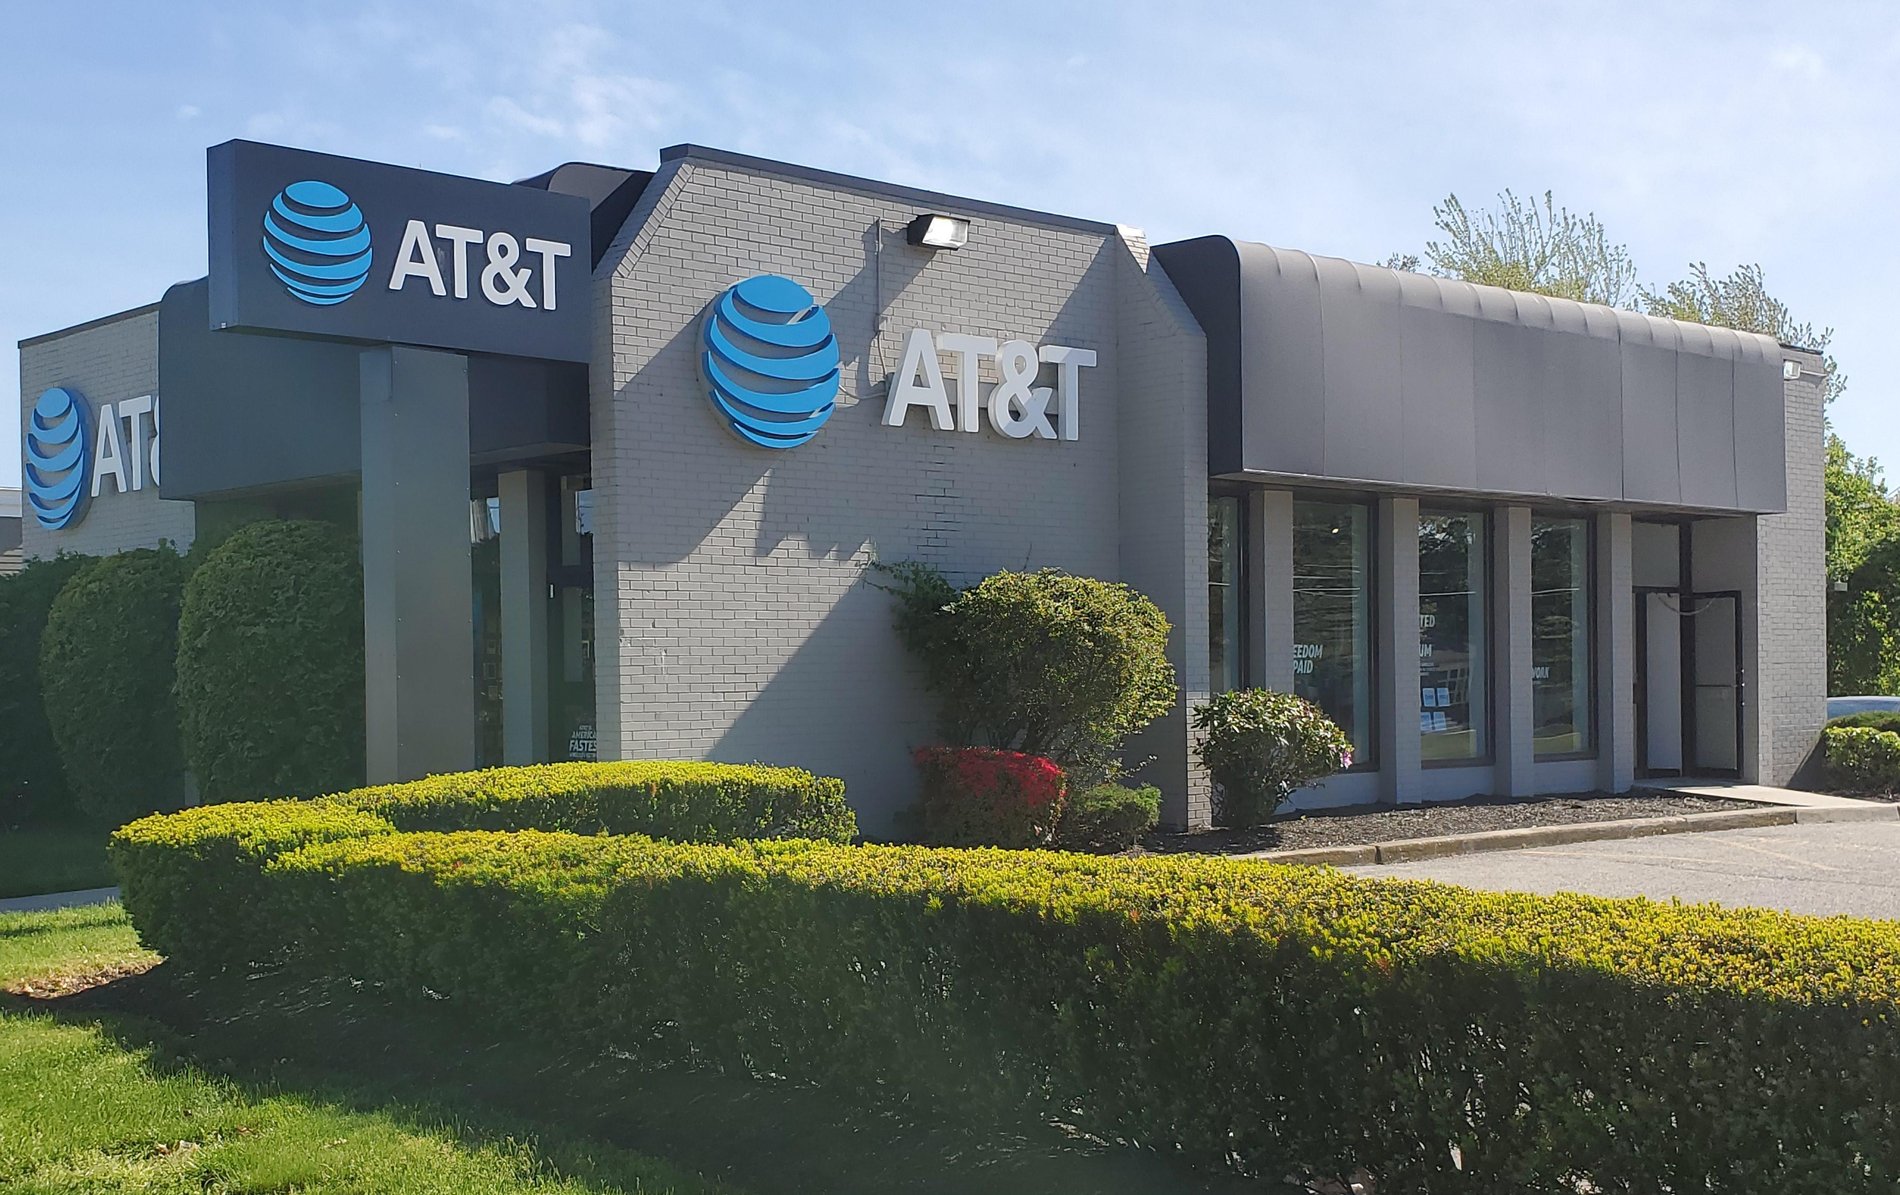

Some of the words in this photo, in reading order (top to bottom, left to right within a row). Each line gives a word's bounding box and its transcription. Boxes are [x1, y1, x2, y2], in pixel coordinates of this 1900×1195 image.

[389, 219, 571, 311] AT&T
[881, 328, 1097, 441] AT&T
[1293, 659, 1313, 674] PAID
